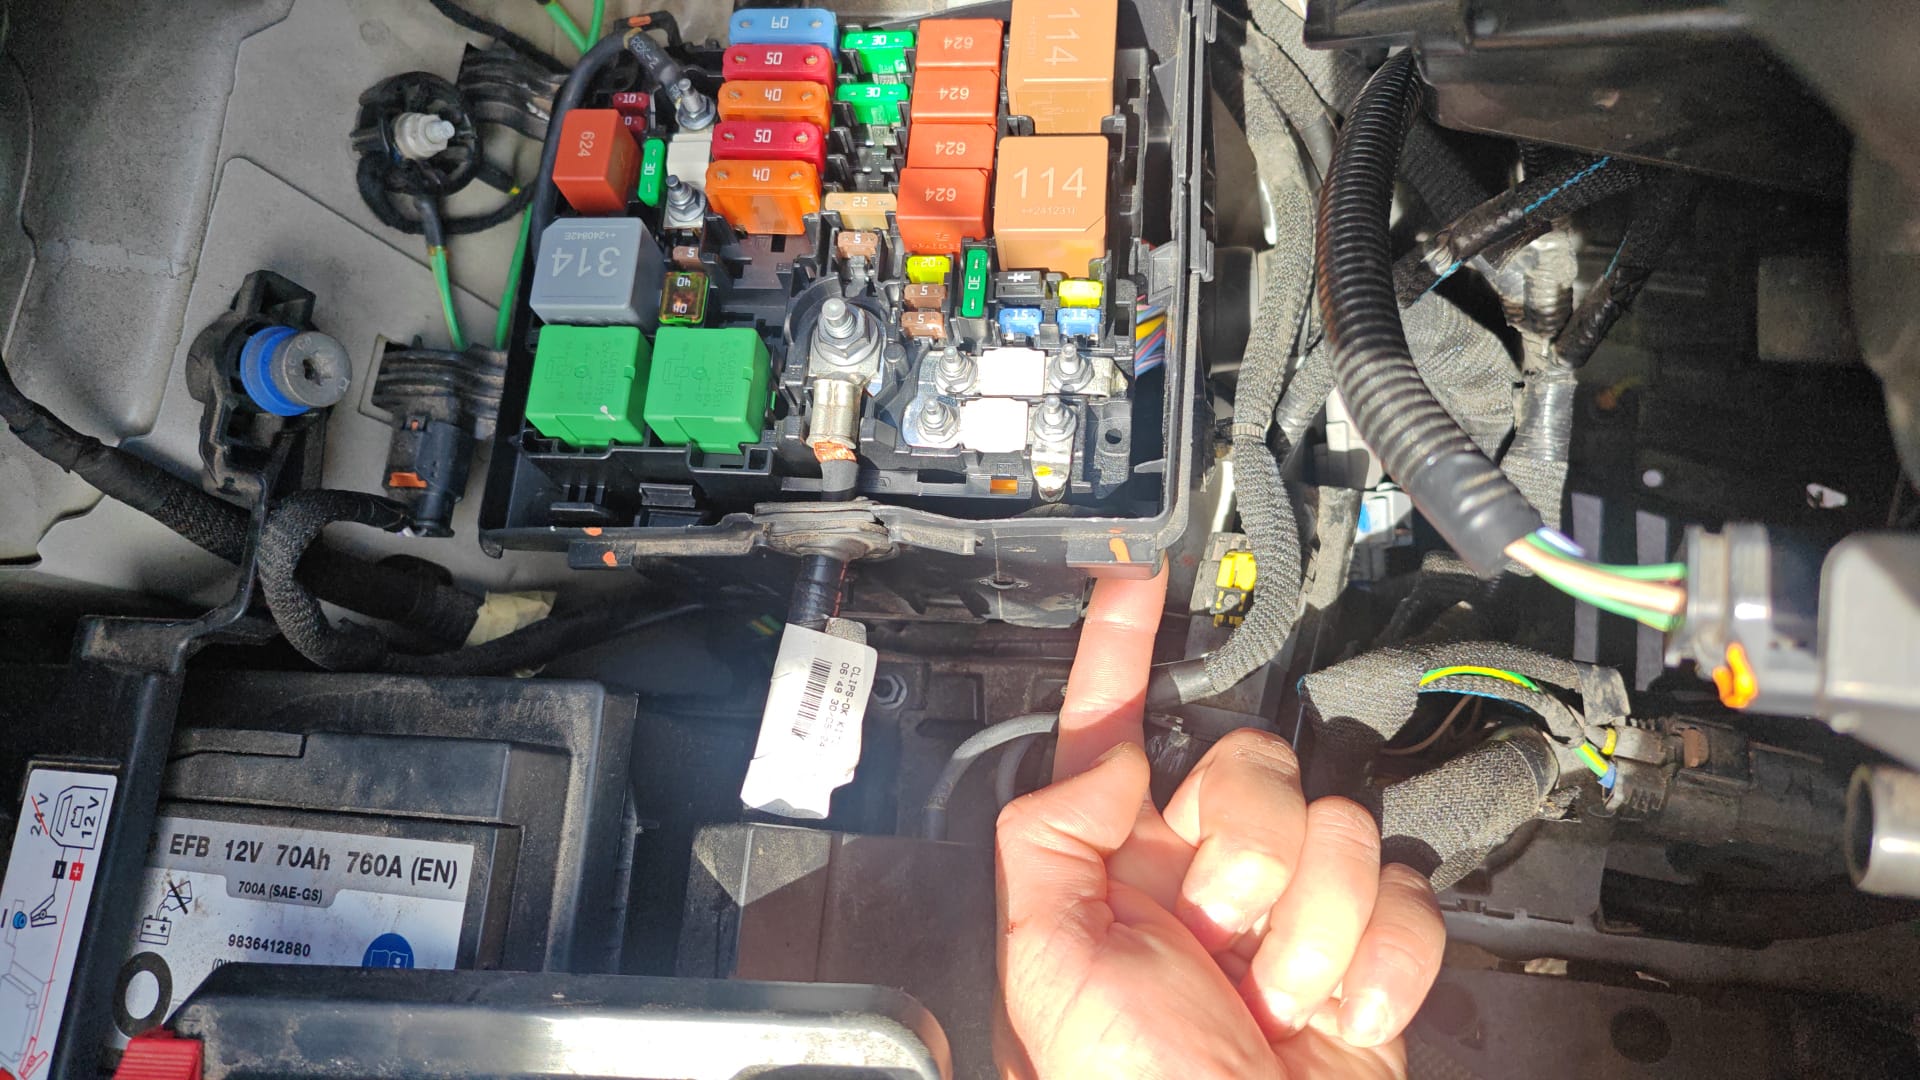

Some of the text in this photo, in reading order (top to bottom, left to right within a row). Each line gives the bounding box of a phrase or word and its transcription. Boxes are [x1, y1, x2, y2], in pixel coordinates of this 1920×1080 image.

[771, 15, 789, 29] 60
[871, 35, 887, 46] 30
[943, 36, 974, 49] 624
[1044, 7, 1081, 66] 114
[764, 51, 783, 66] 50
[622, 93, 637, 104] 10
[764, 88, 782, 102] 40
[865, 87, 881, 98] 30
[939, 87, 970, 101] 624
[753, 129, 772, 143] 50
[577, 131, 595, 157] 624
[935, 141, 966, 155] 624
[643, 161, 657, 176] 30
[752, 168, 770, 182] 40
[1013, 167, 1087, 200] 114
[852, 196, 868, 207] 25
[925, 187, 957, 202] 624
[853, 233, 862, 244] 5
[686, 247, 696, 258] 5
[551, 246, 621, 278] 314
[920, 256, 937, 268] 20
[967, 274, 981, 290] 30
[919, 285, 929, 296] 5
[916, 313, 925, 324] 5
[1072, 309, 1087, 321] 15
[839, 666, 862, 717] CLIPS-OK
[169, 833, 459, 889] EFB 12V 70Ah 760A (EN)
[238, 881, 323, 904] 700A (SAE-GS)
[228, 934, 311, 958] 9836412880
